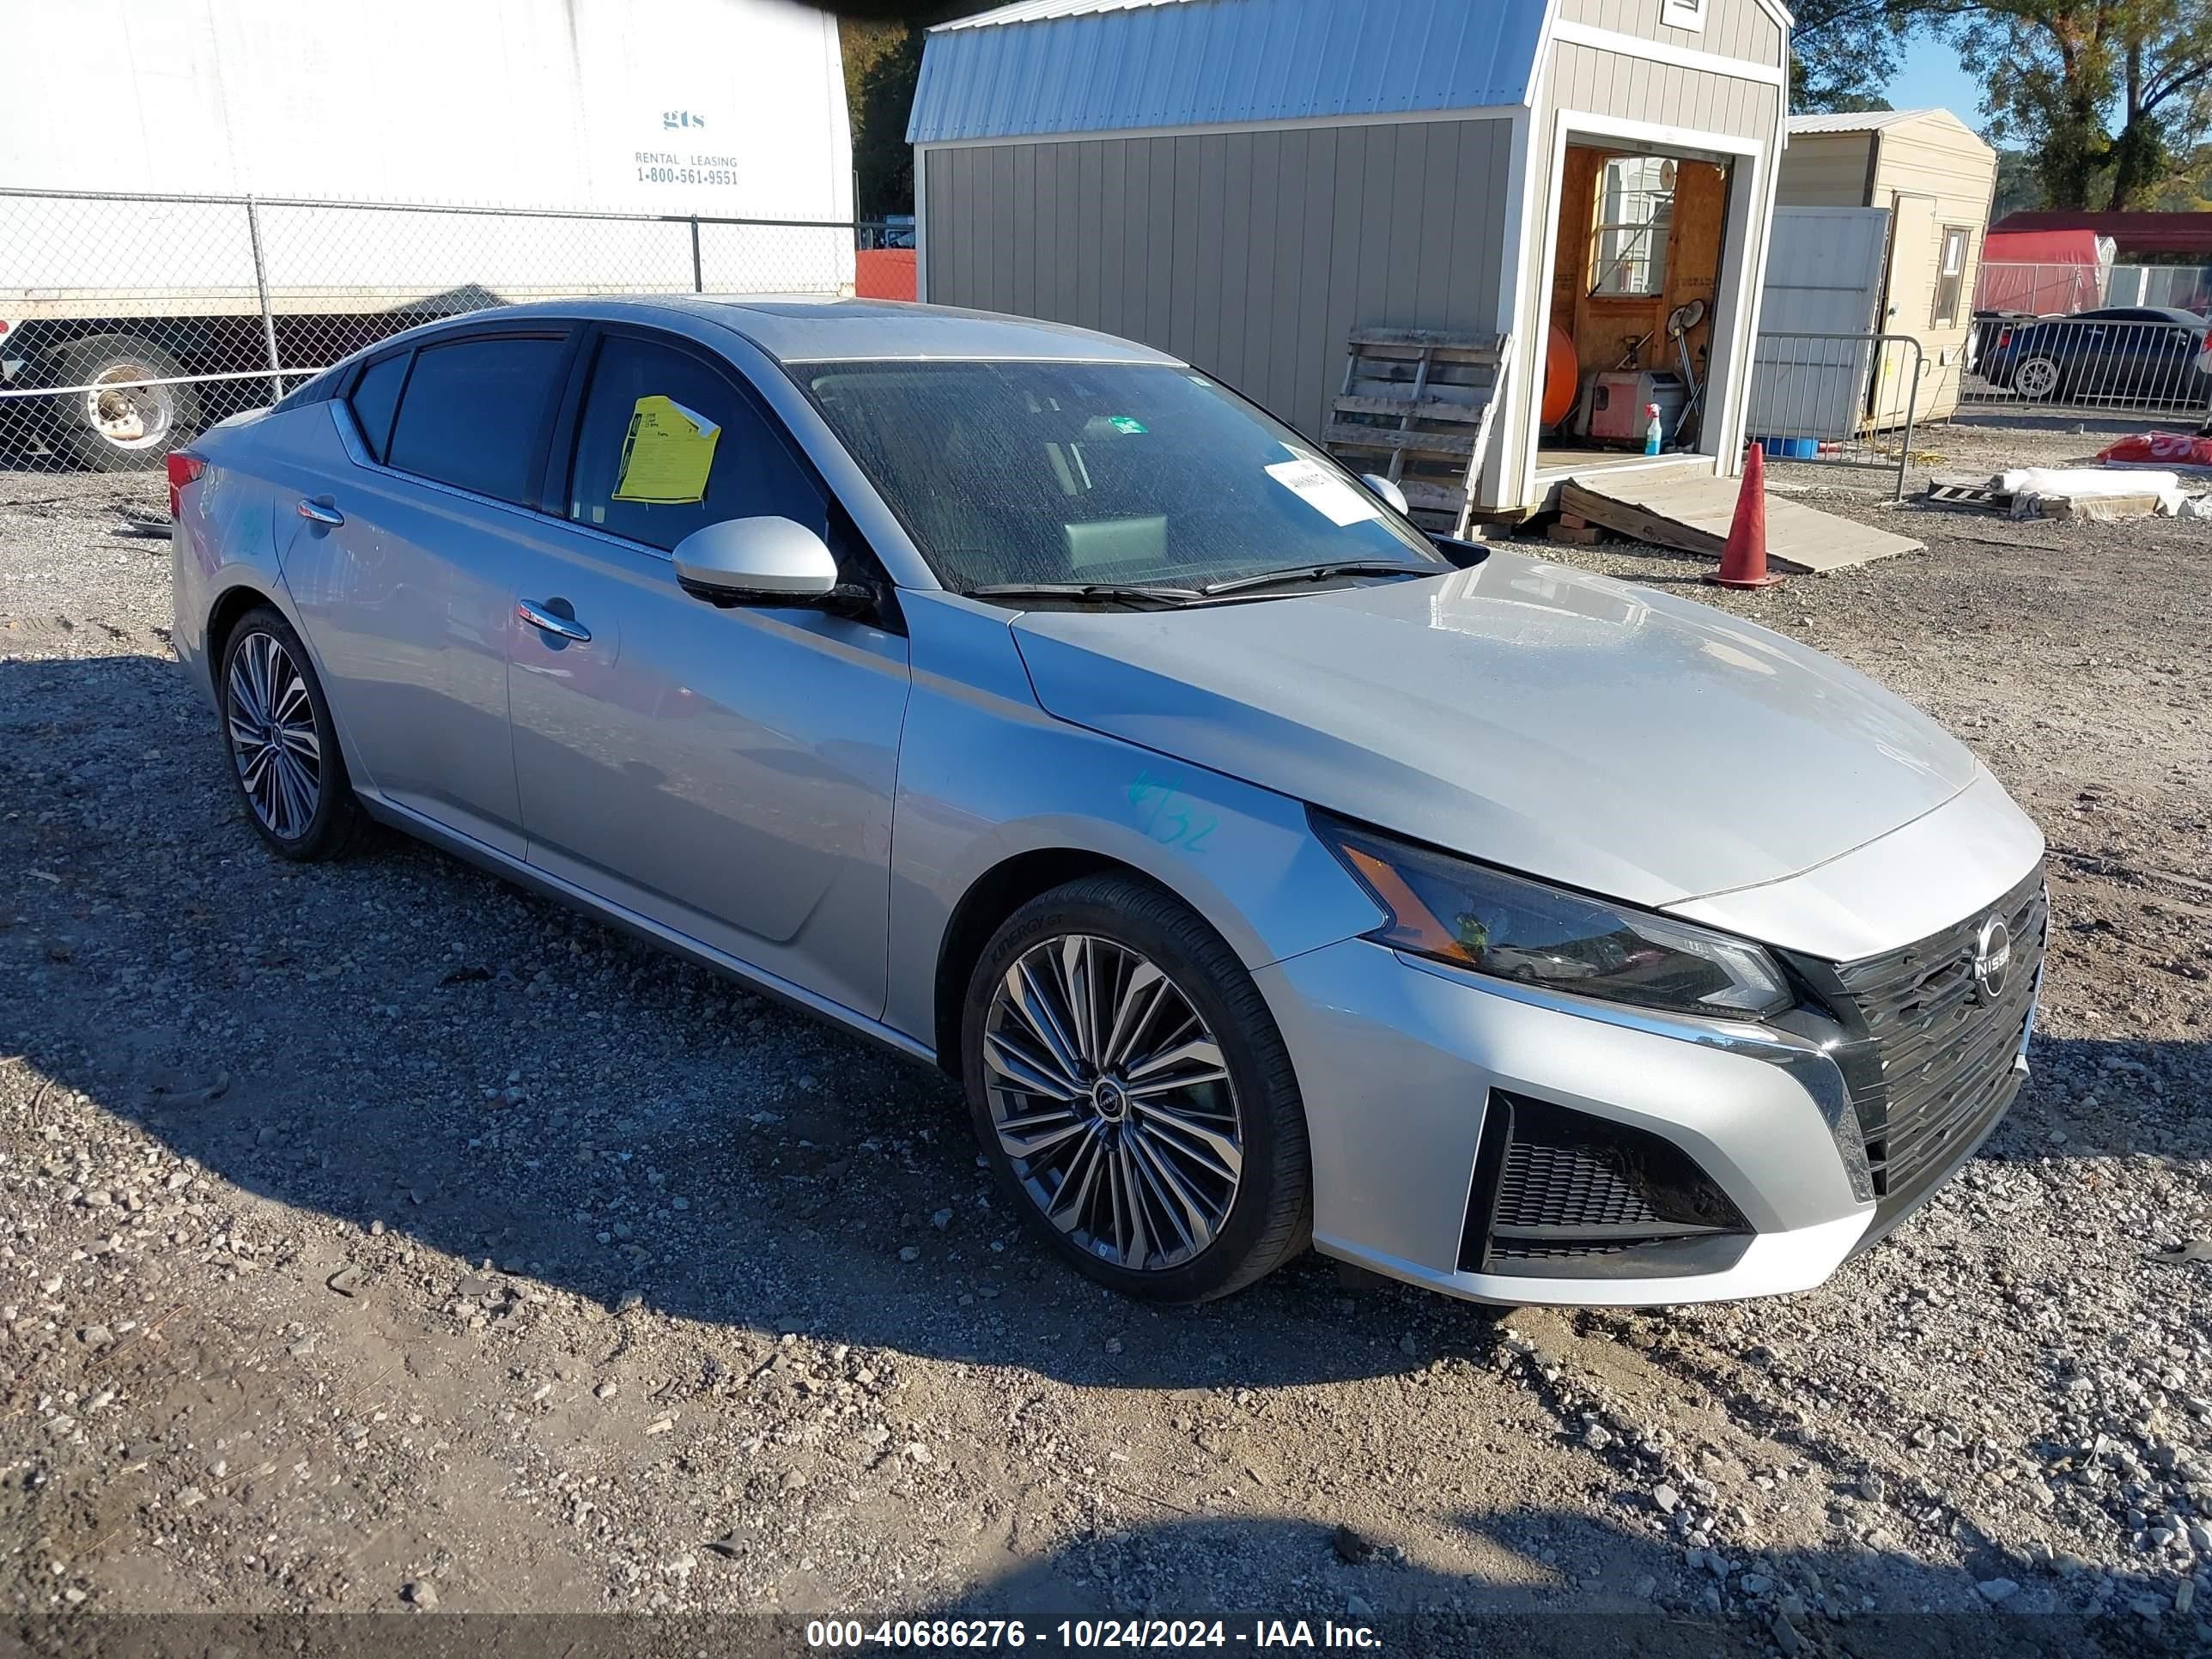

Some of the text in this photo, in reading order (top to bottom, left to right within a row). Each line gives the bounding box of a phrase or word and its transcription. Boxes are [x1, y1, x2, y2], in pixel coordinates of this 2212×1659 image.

[663, 110, 705, 131] gts
[635, 152, 738, 167] RENTAL LEASING
